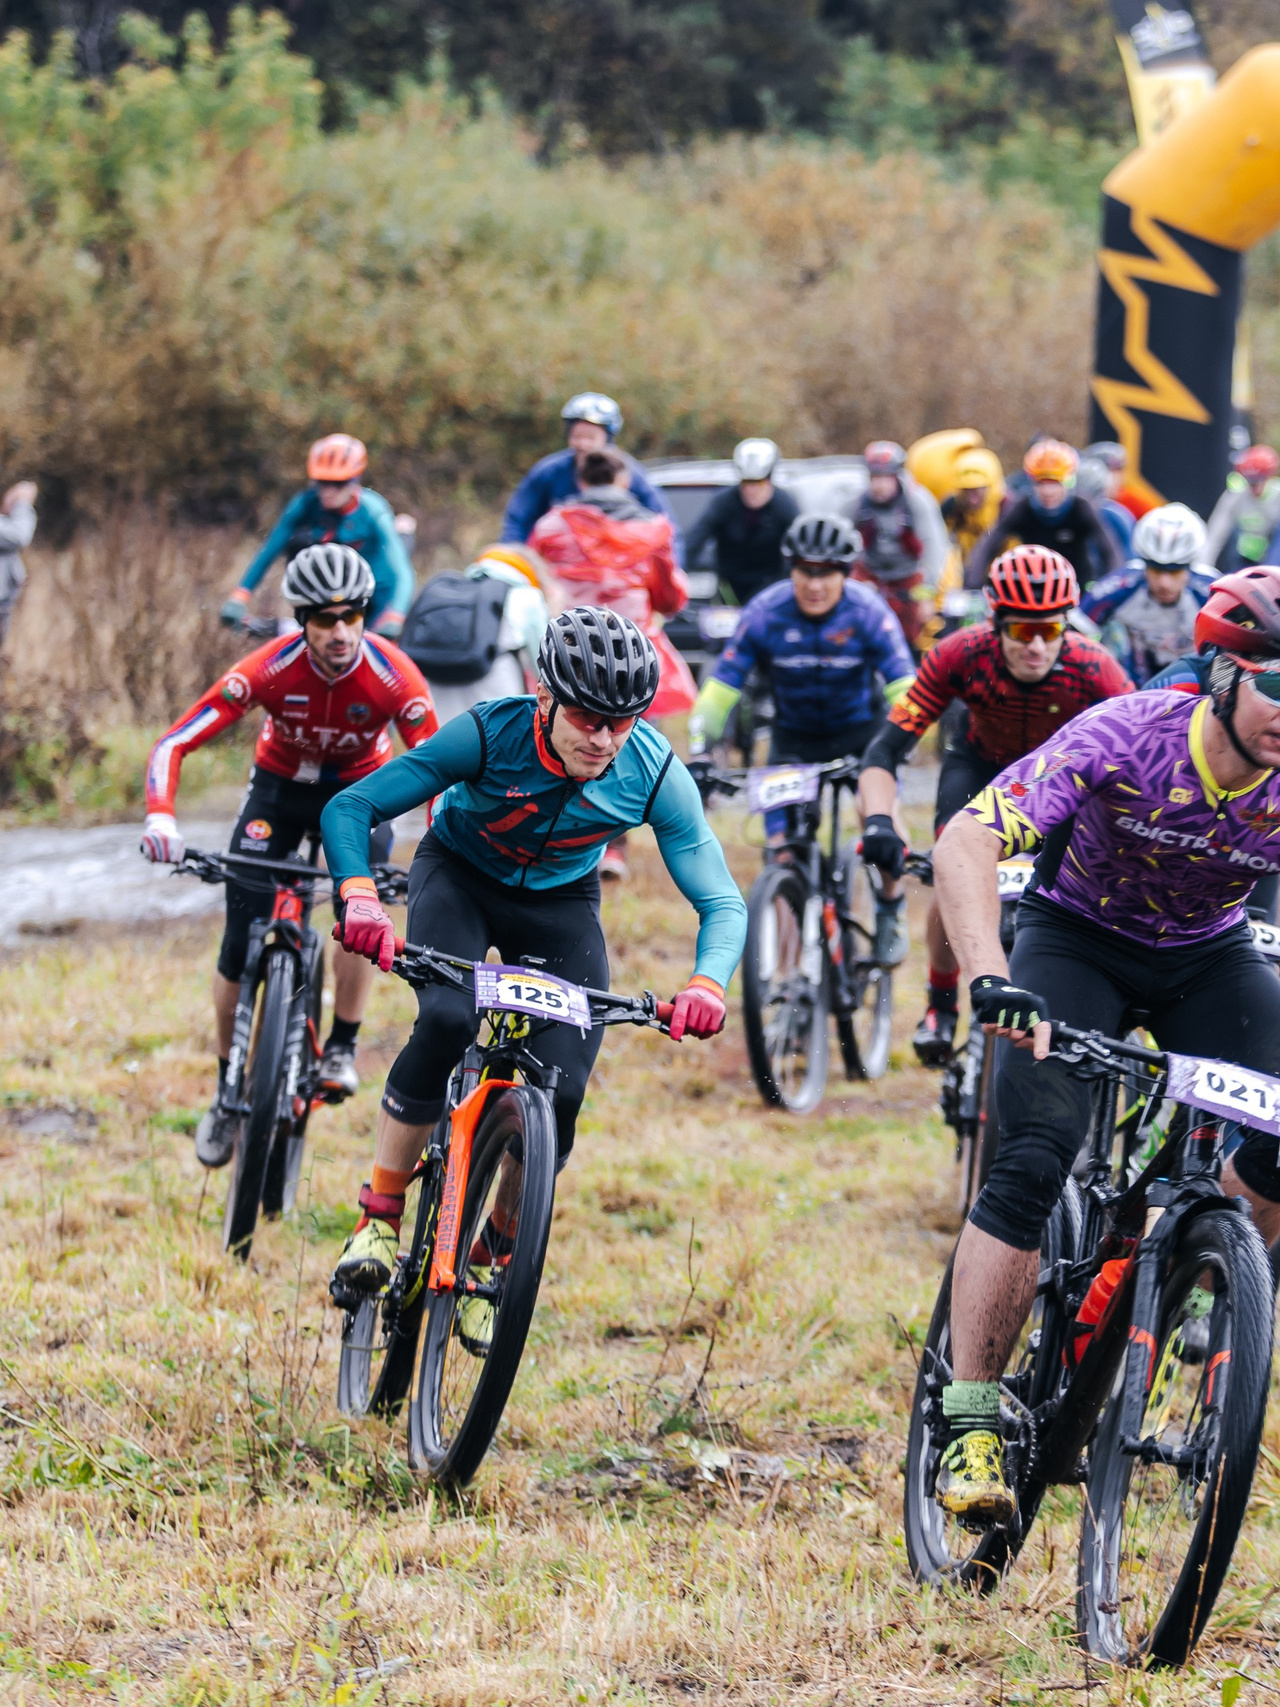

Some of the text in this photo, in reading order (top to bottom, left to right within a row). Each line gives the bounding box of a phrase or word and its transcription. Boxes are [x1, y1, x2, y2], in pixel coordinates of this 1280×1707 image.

[997, 871, 1032, 886] 04
[508, 984, 563, 1009] 125
[1206, 1071, 1267, 1109] 021
